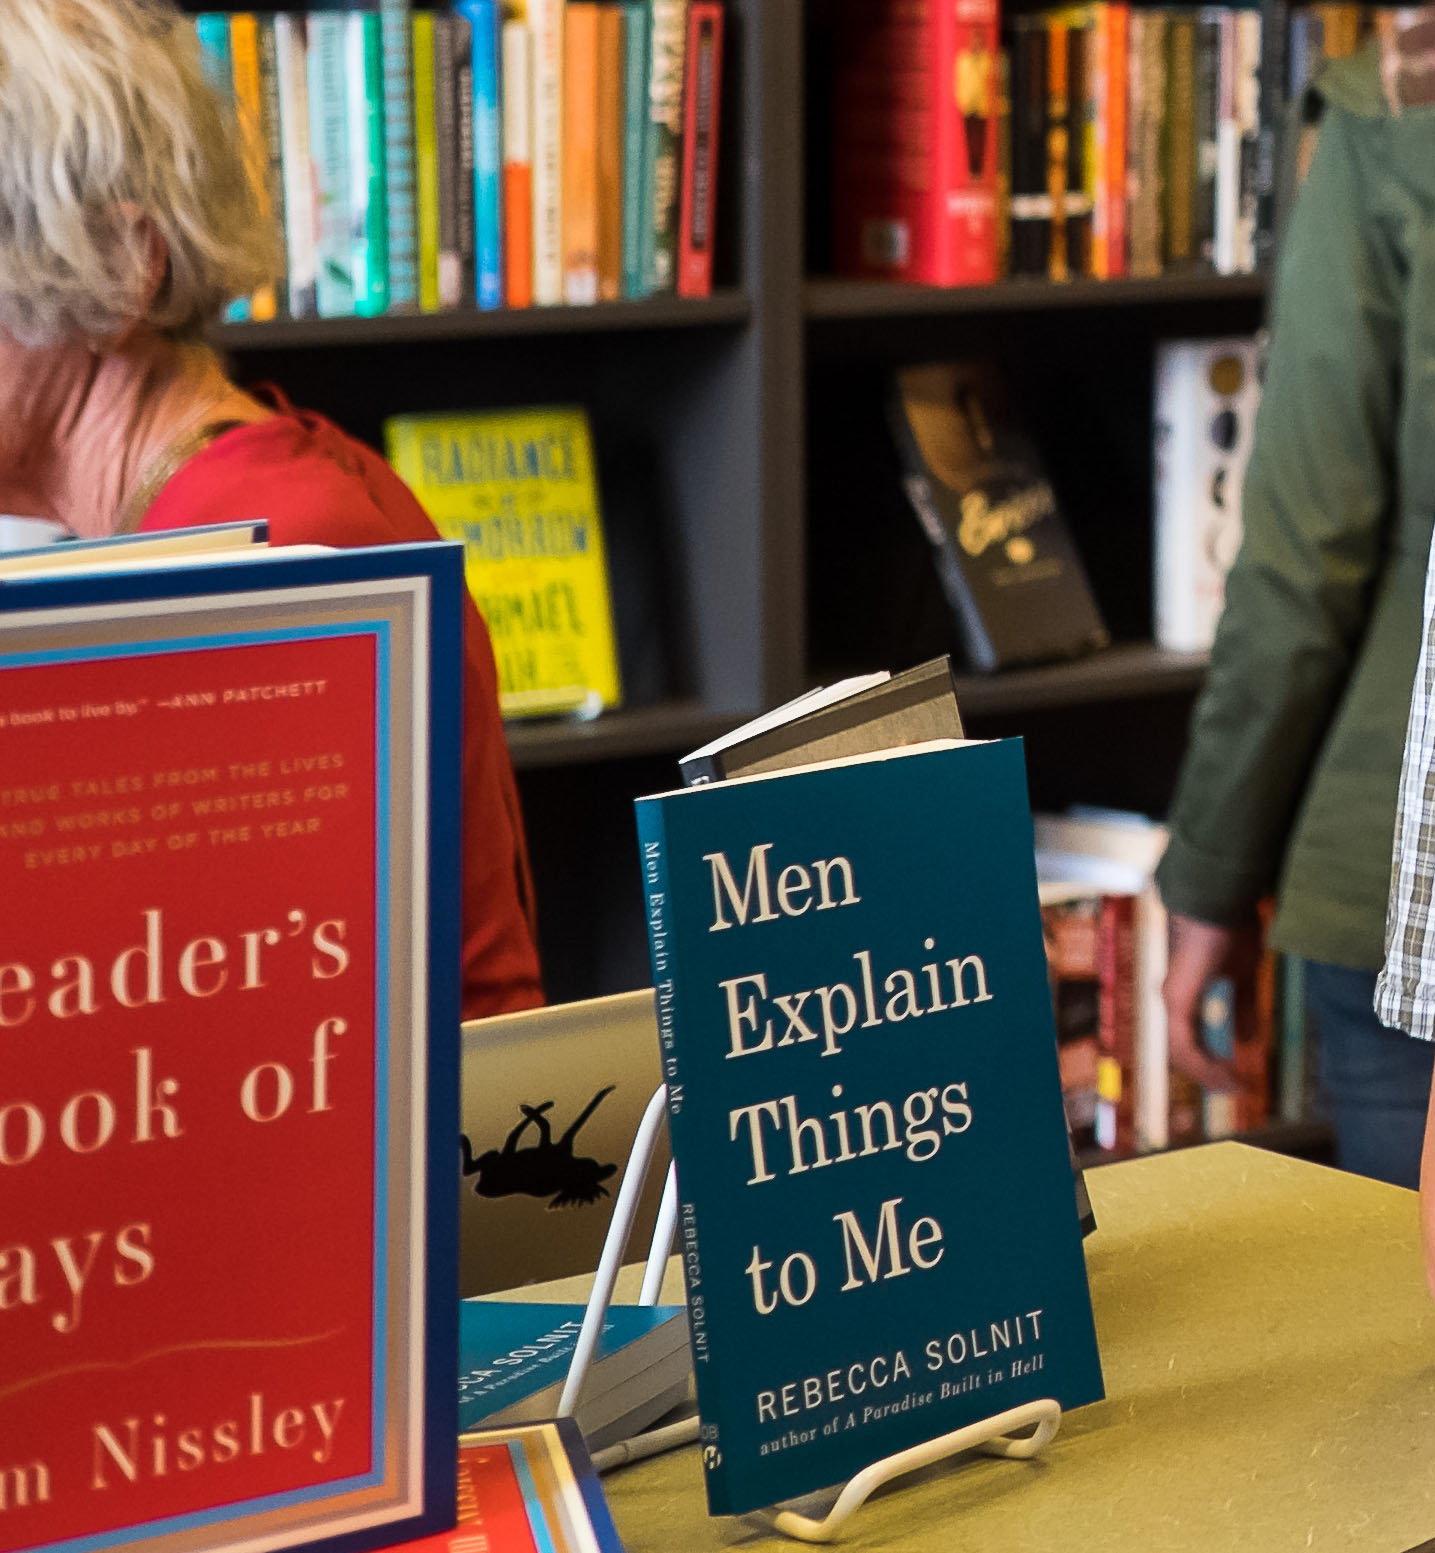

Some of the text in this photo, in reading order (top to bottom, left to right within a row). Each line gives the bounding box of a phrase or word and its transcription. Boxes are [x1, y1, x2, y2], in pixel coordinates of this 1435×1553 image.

[10, 701, 55, 726] book
[59, 706, 77, 721] to
[81, 703, 111, 719] live
[223, 679, 328, 704] PATCHETT
[55, 808, 143, 832] WORKS
[152, 802, 183, 822] OF
[192, 790, 296, 816] WRITERS
[303, 782, 349, 803] FOR
[71, 776, 144, 797] TALES
[153, 768, 220, 789] FROM
[229, 761, 271, 781] THE
[280, 752, 344, 775] LIVES
[24, 817, 322, 870] EVERY DAY OF THE YEAR
[703, 842, 862, 933] Men
[0, 909, 350, 1027] eader's
[644, 841, 684, 1115] Men Explain Things to Me
[718, 937, 994, 1060] Explain
[0, 1015, 348, 1166] ook of
[730, 1081, 974, 1186] Things
[0, 1221, 155, 1334] ays
[682, 1203, 710, 1363] REBECCA SOLNIT
[746, 1197, 946, 1316] to Me
[493, 1321, 583, 1366] SOLNIT
[757, 1309, 1043, 1424] REBECCA SOLNIT
[92, 1391, 345, 1490] Nissley
[760, 1353, 1046, 1457] author of A Paradise Built in Hell
